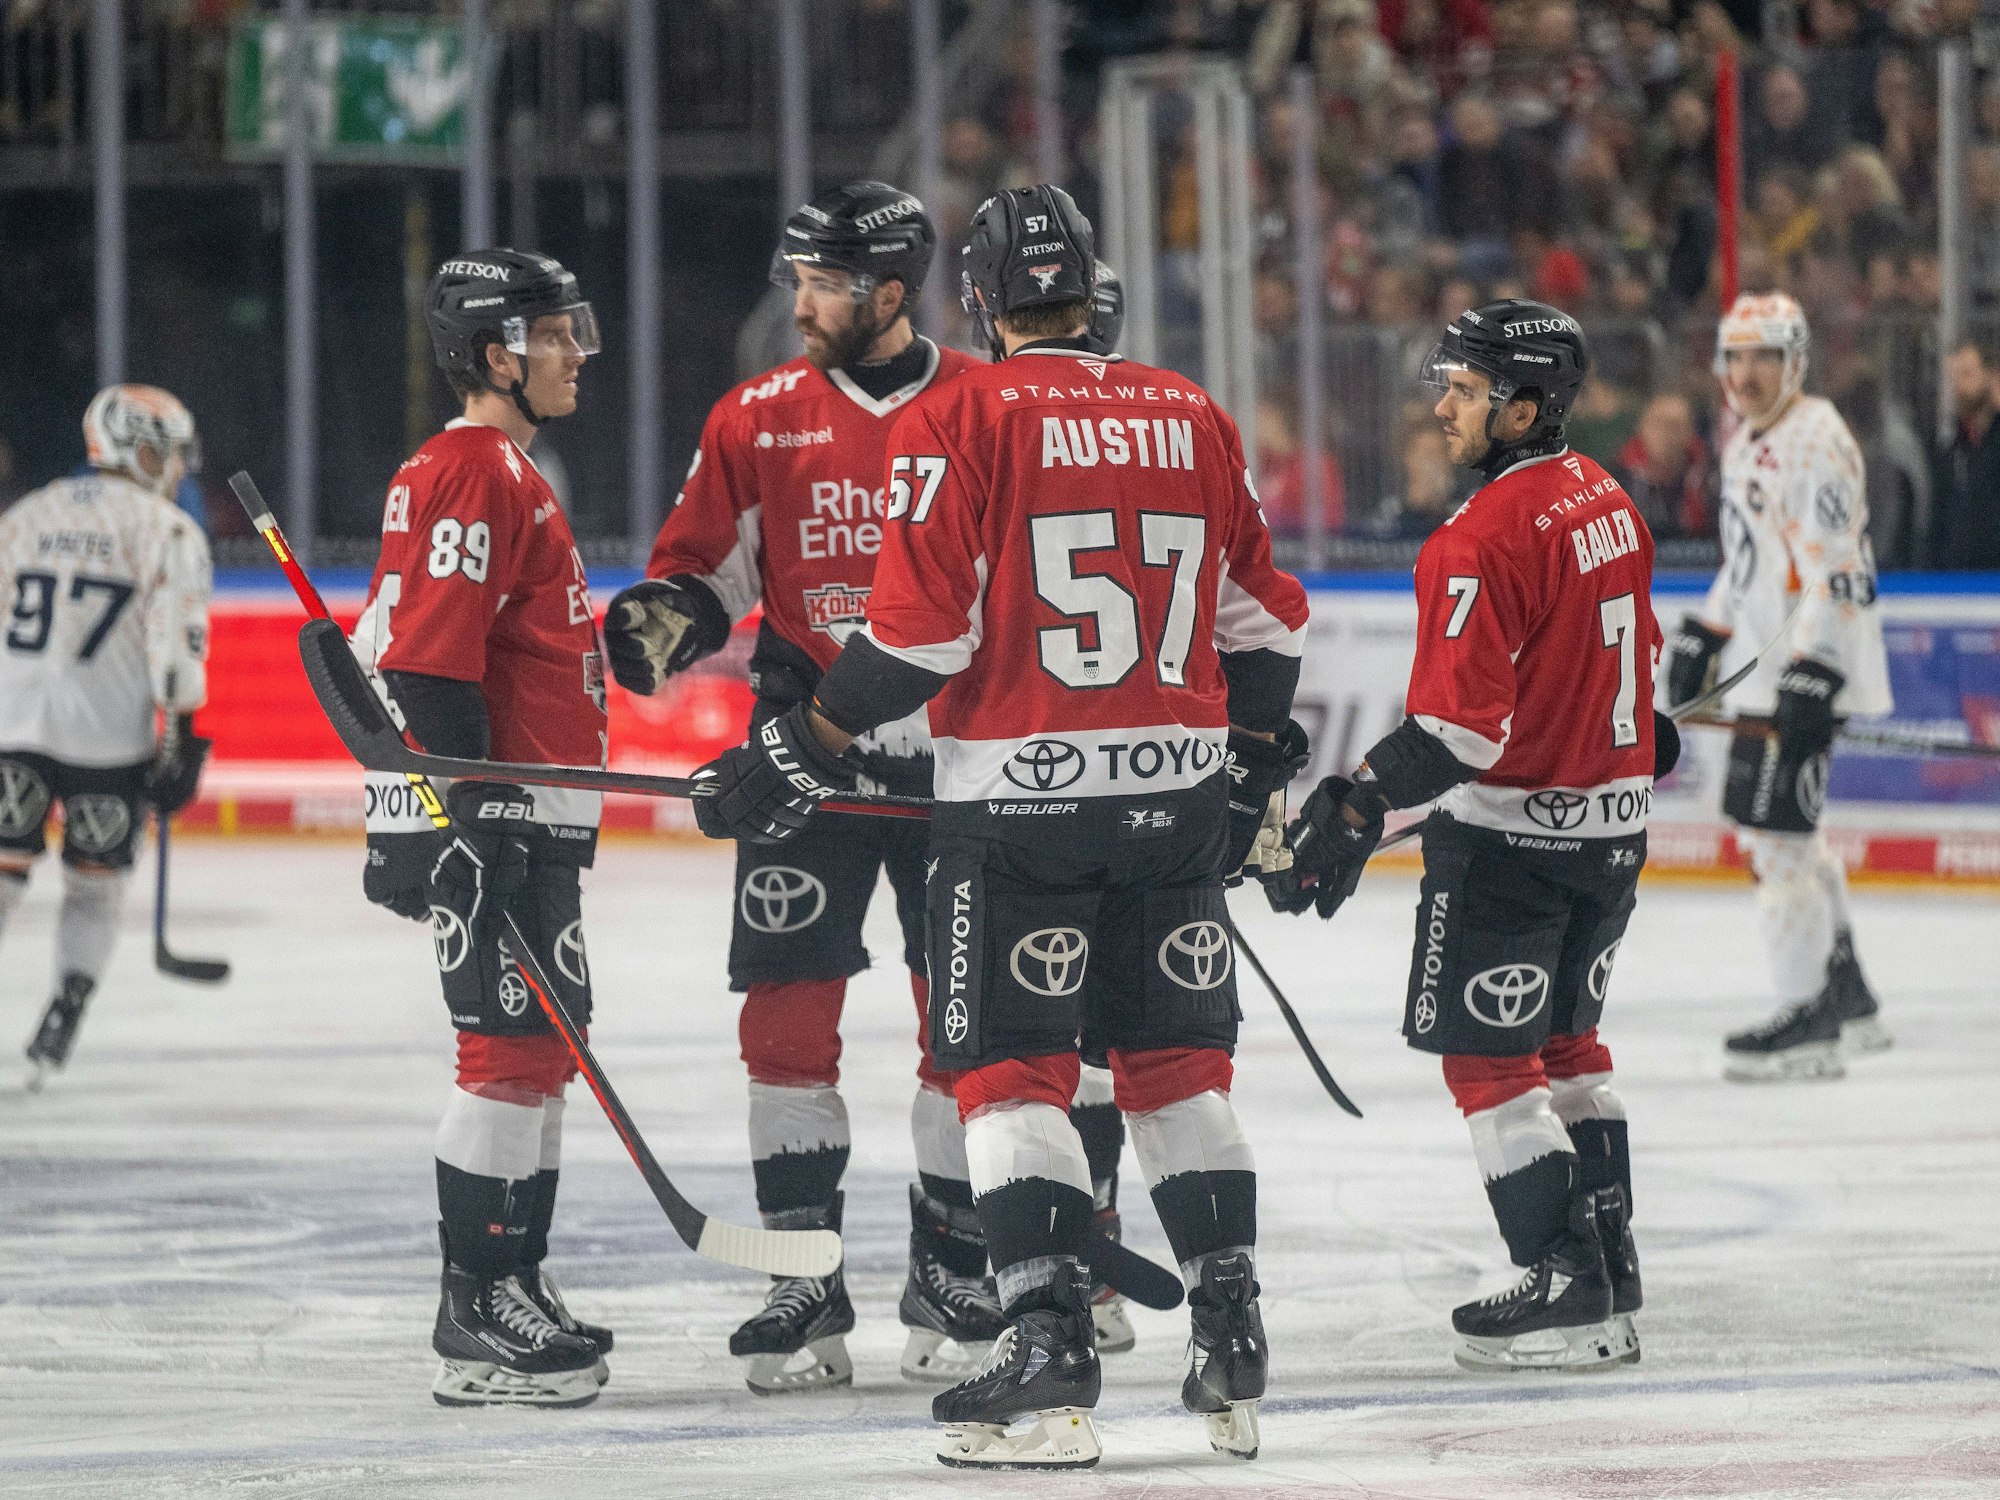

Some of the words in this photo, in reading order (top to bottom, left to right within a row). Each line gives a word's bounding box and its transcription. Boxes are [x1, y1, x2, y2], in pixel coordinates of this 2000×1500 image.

[1025, 215, 1048, 234] 57
[1022, 241, 1065, 257] STETSON
[438, 260, 511, 282] STETSON
[1503, 318, 1576, 338] STETSON
[1513, 353, 1554, 365] BAUER
[776, 426, 834, 448] steinel
[1042, 416, 1195, 471] AUSTIN
[887, 456, 947, 523] 57
[428, 517, 492, 585] 89
[799, 517, 883, 560] Ene
[1571, 507, 1640, 576] BAILEN
[1028, 508, 1207, 691] 57
[1445, 575, 1482, 640] 7
[1828, 571, 1877, 607] 93
[7, 570, 137, 660] 97
[1598, 591, 1638, 748] 7
[1098, 738, 1223, 781] TOYO
[365, 784, 425, 818] OYOT
[1001, 802, 1079, 815] BAUER
[558, 829, 592, 840] BAUER
[1518, 837, 1583, 852] BAUER
[950, 879, 972, 995] TOYOTA
[1422, 891, 1449, 989] TOYOTA
[477, 1331, 517, 1362] BAUER
